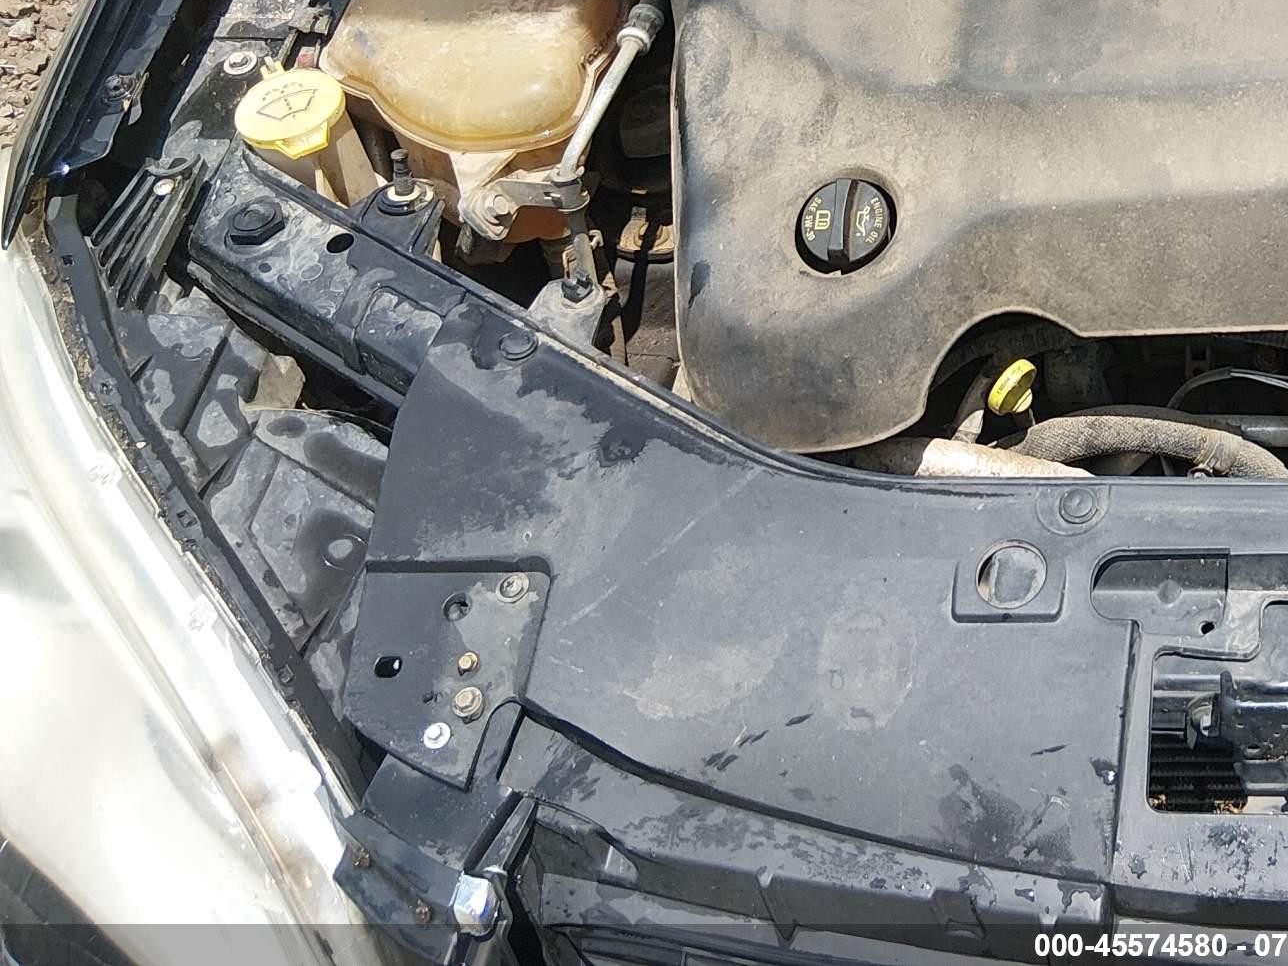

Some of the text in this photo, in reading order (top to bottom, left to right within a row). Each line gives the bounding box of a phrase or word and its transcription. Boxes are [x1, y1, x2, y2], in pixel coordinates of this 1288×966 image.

[808, 197, 821, 211] SAE
[865, 197, 884, 243] ENGINE OIL
